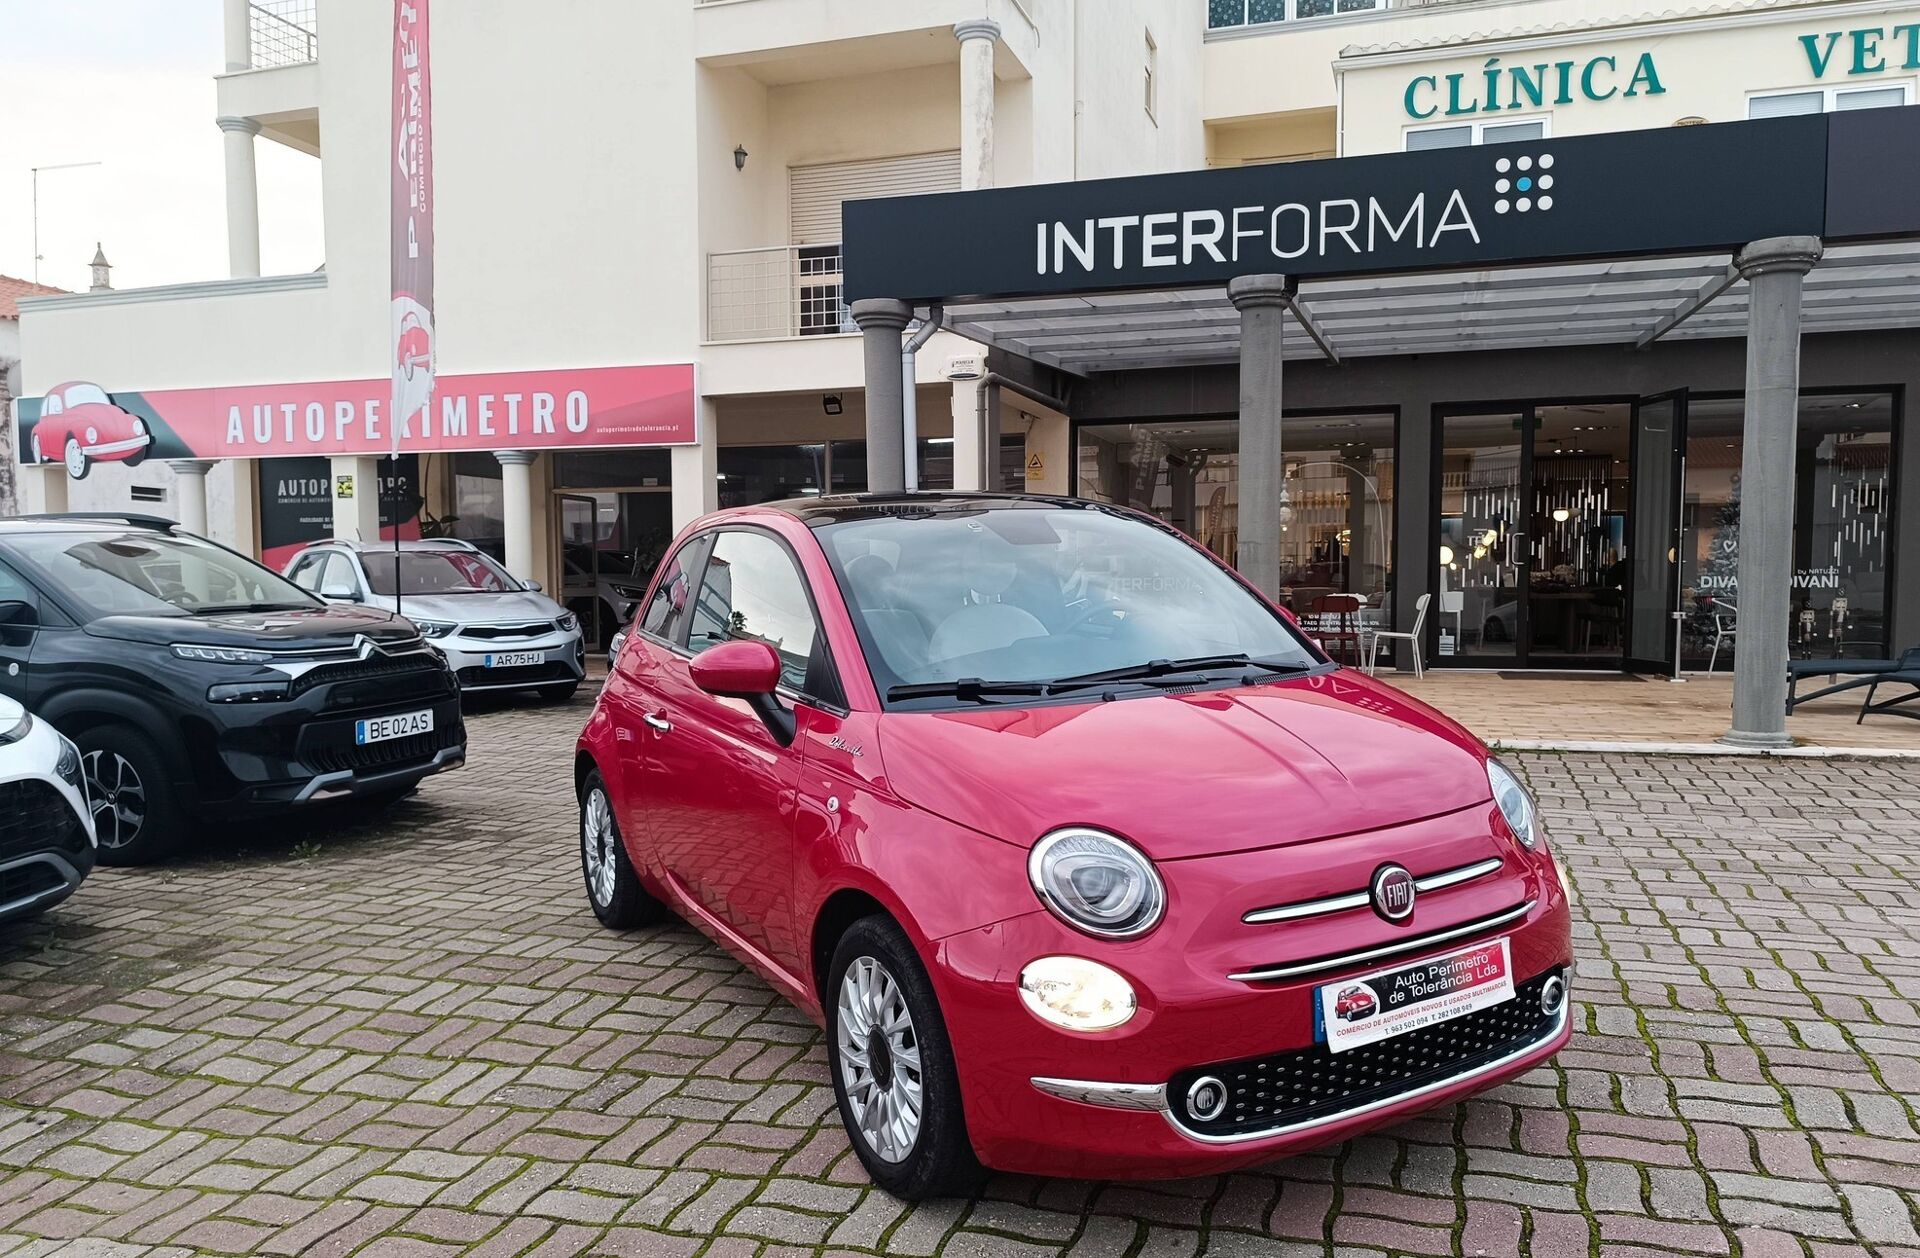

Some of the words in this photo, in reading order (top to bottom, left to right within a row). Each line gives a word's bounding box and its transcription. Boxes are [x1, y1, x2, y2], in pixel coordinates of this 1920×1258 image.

[1404, 52, 1666, 119] CLÍNICA
[1037, 189, 1480, 274] INTERFORMA
[1700, 575, 1738, 588] DIVA
[1386, 881, 1408, 907] FIAT
[1389, 990, 1405, 1005] de
[1408, 971, 1473, 997] Tolerância
[1477, 964, 1501, 980] Lda.
[1394, 971, 1425, 989] Auto
[1429, 954, 1489, 982] Perímetro
[1373, 1019, 1381, 1027] DE
[1421, 1000, 1442, 1013] NOVOS
[1449, 993, 1471, 1004] USADOS
[1472, 980, 1507, 996] MULTIMARCAS
[1404, 1020, 1416, 1029] 502
[1417, 1016, 1428, 1026] 094
[1438, 1011, 1449, 1019] 282
[1450, 1007, 1461, 1015] 108
